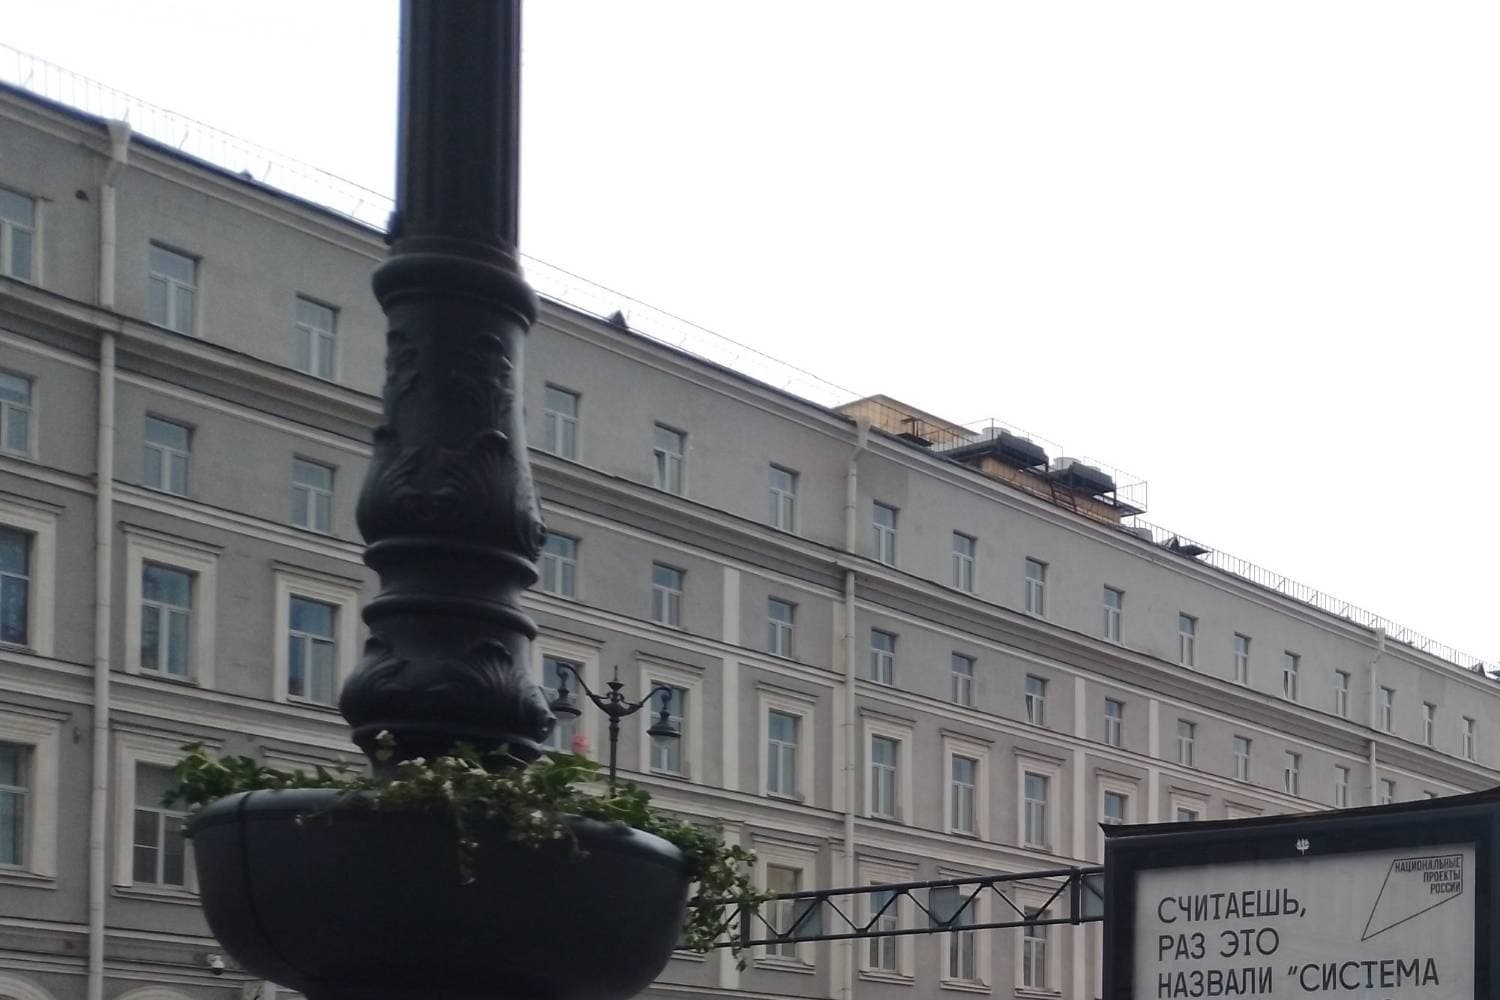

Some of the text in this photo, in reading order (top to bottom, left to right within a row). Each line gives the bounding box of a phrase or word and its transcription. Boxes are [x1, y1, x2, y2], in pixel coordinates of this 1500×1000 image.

[1395, 857, 1460, 873] НАЦИОНАЛЬНЫЕ
[1423, 870, 1461, 883] ПРОЕКТЫ
[1430, 882, 1461, 895] РОССИИ
[1157, 888, 1307, 923] СЧИТАЕШЬ,
[1158, 928, 1280, 961] РАЗ ЭТО
[1158, 967, 1274, 999] НАЗВАЛИ
